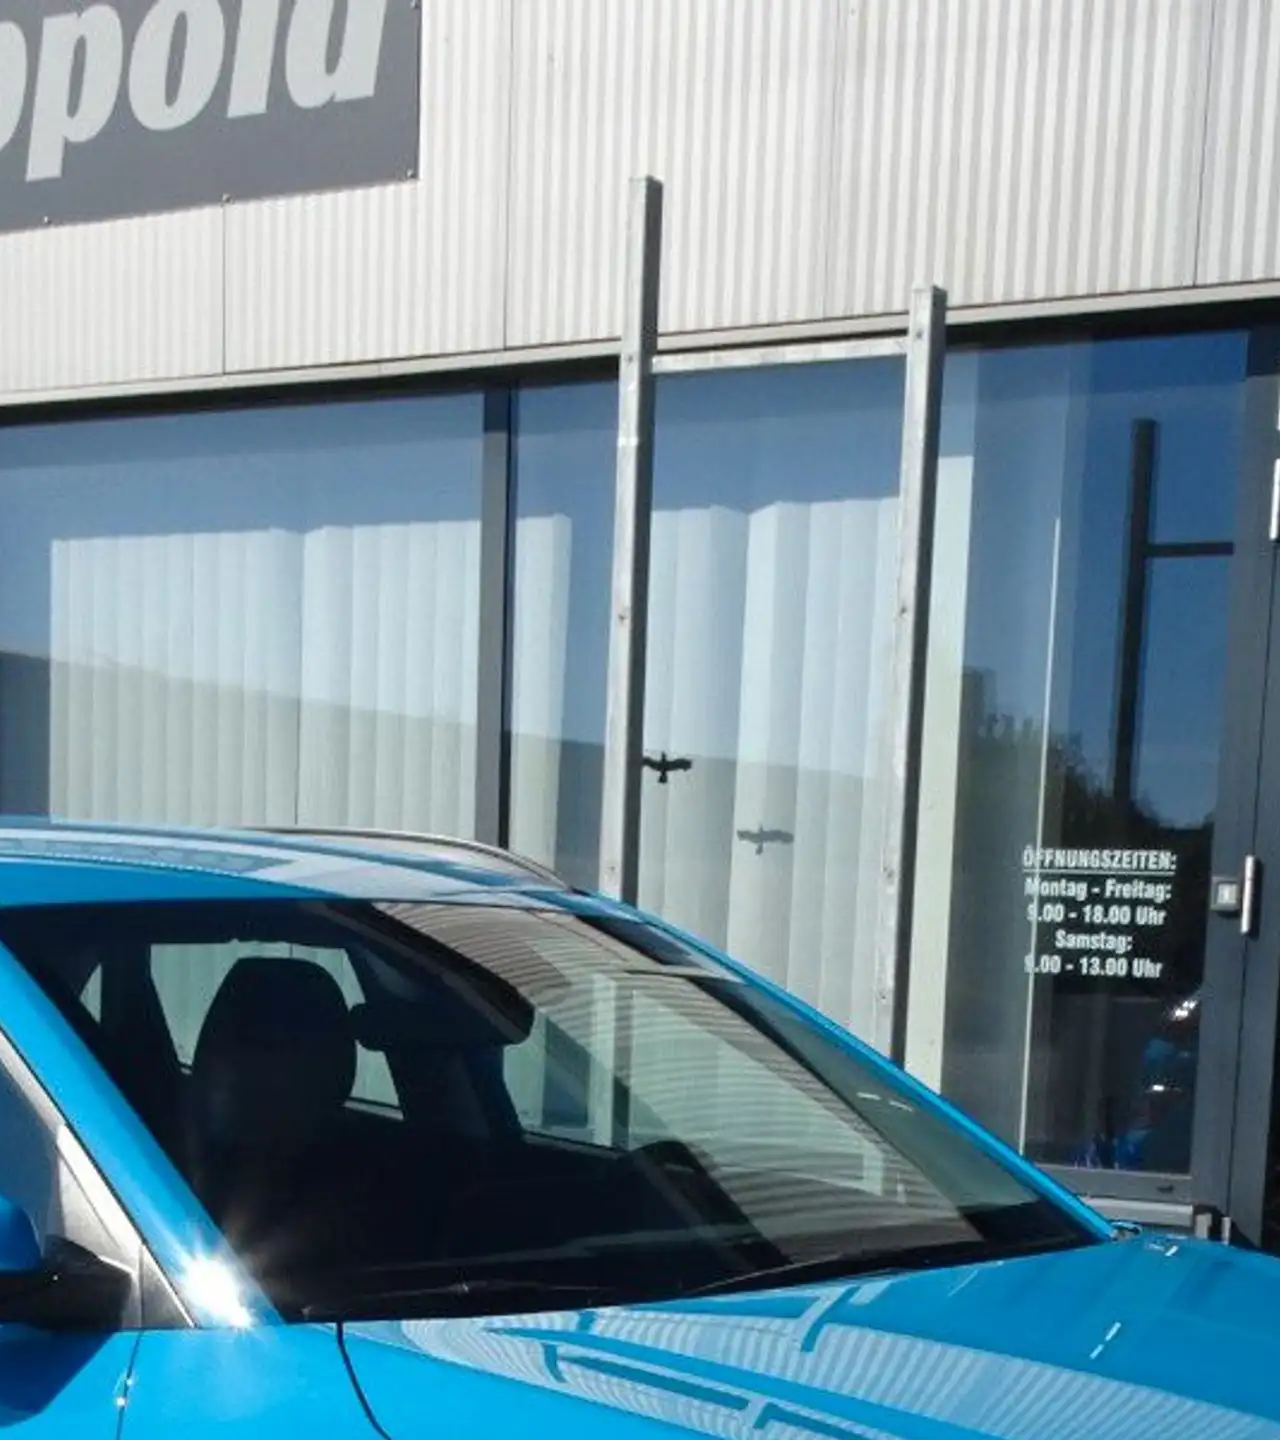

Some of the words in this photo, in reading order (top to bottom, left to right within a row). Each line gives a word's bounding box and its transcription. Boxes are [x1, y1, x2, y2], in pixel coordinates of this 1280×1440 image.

[1023, 844, 1177, 870] ÖFFNUNGSZEITEN:
[1024, 877, 1088, 901] Montag
[1104, 878, 1172, 903] Freitag:
[1082, 905, 1131, 925] 18.00
[1135, 906, 1167, 925] Uhr
[1055, 929, 1133, 953] Samstag:
[1079, 957, 1127, 977] 13.00
[1132, 958, 1163, 978] Uhr
